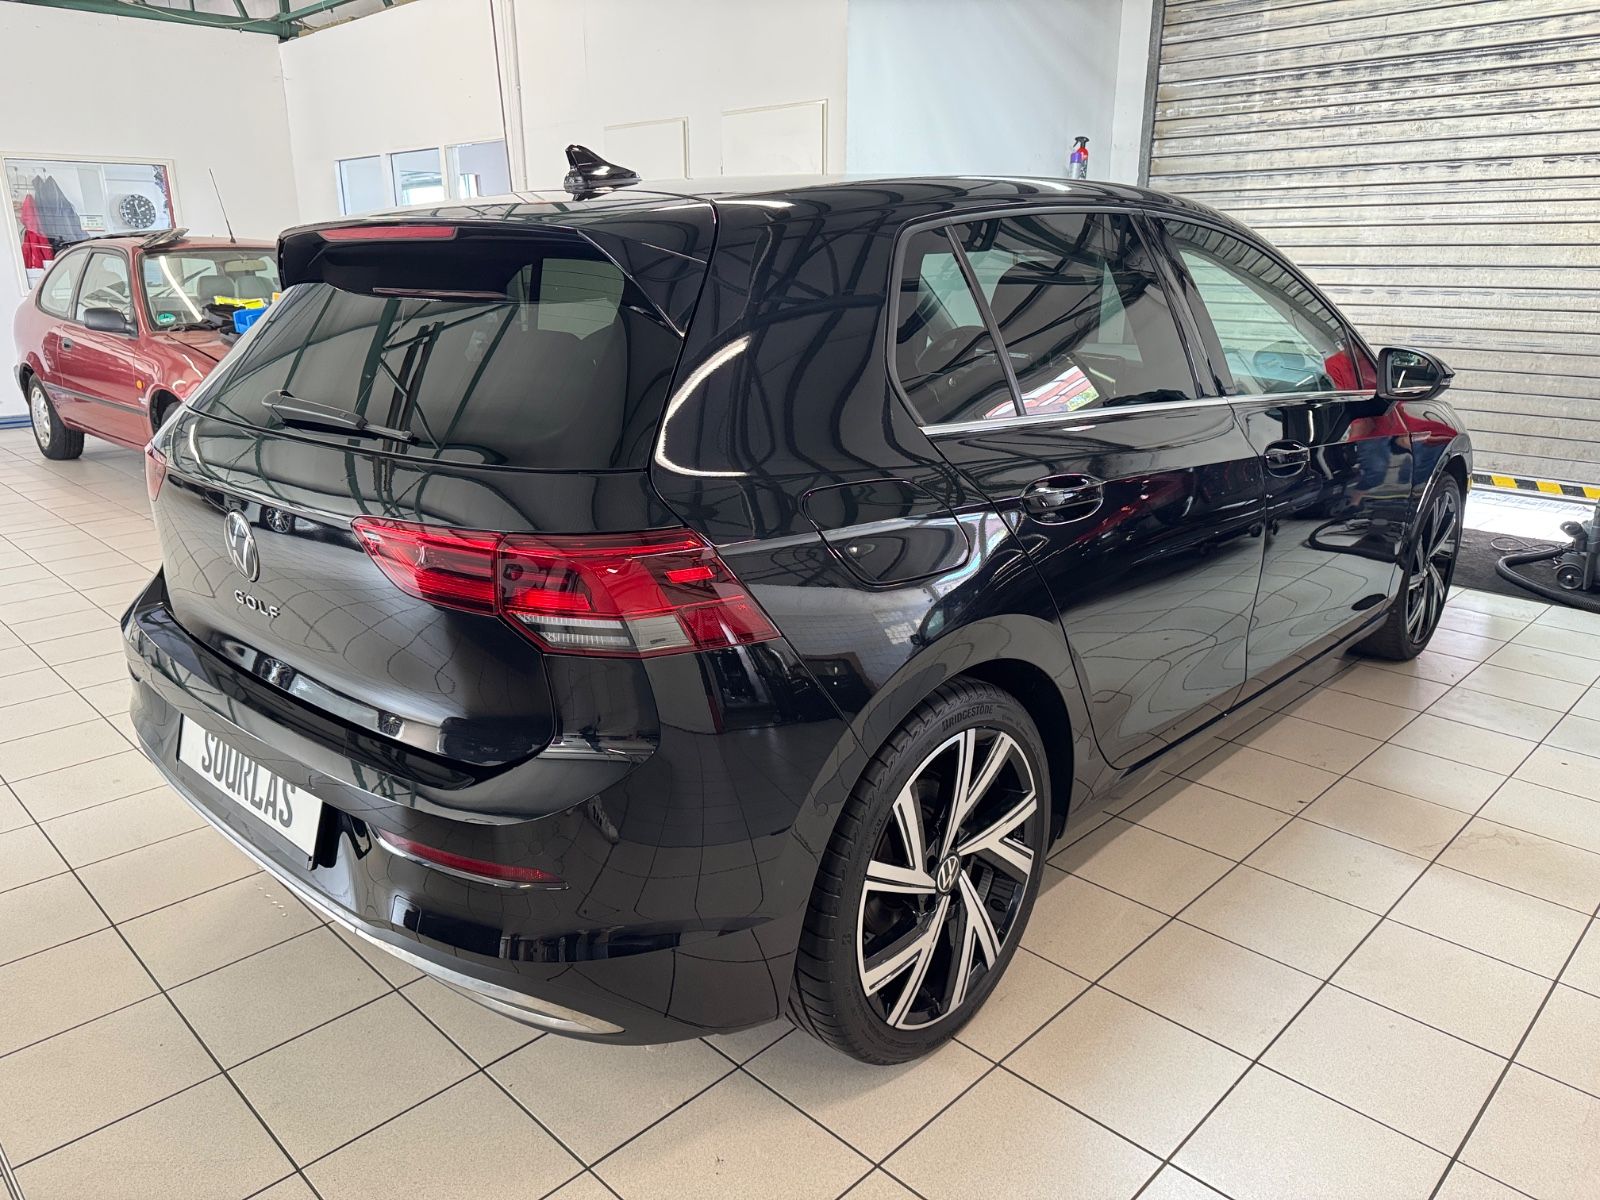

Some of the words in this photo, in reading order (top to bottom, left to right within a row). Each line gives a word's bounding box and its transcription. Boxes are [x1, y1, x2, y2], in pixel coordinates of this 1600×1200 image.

[234, 590, 280, 618] GOLF
[941, 705, 993, 732] BRIDGESTONE
[201, 730, 296, 828] SOURLAS
[938, 856, 960, 892] VW
